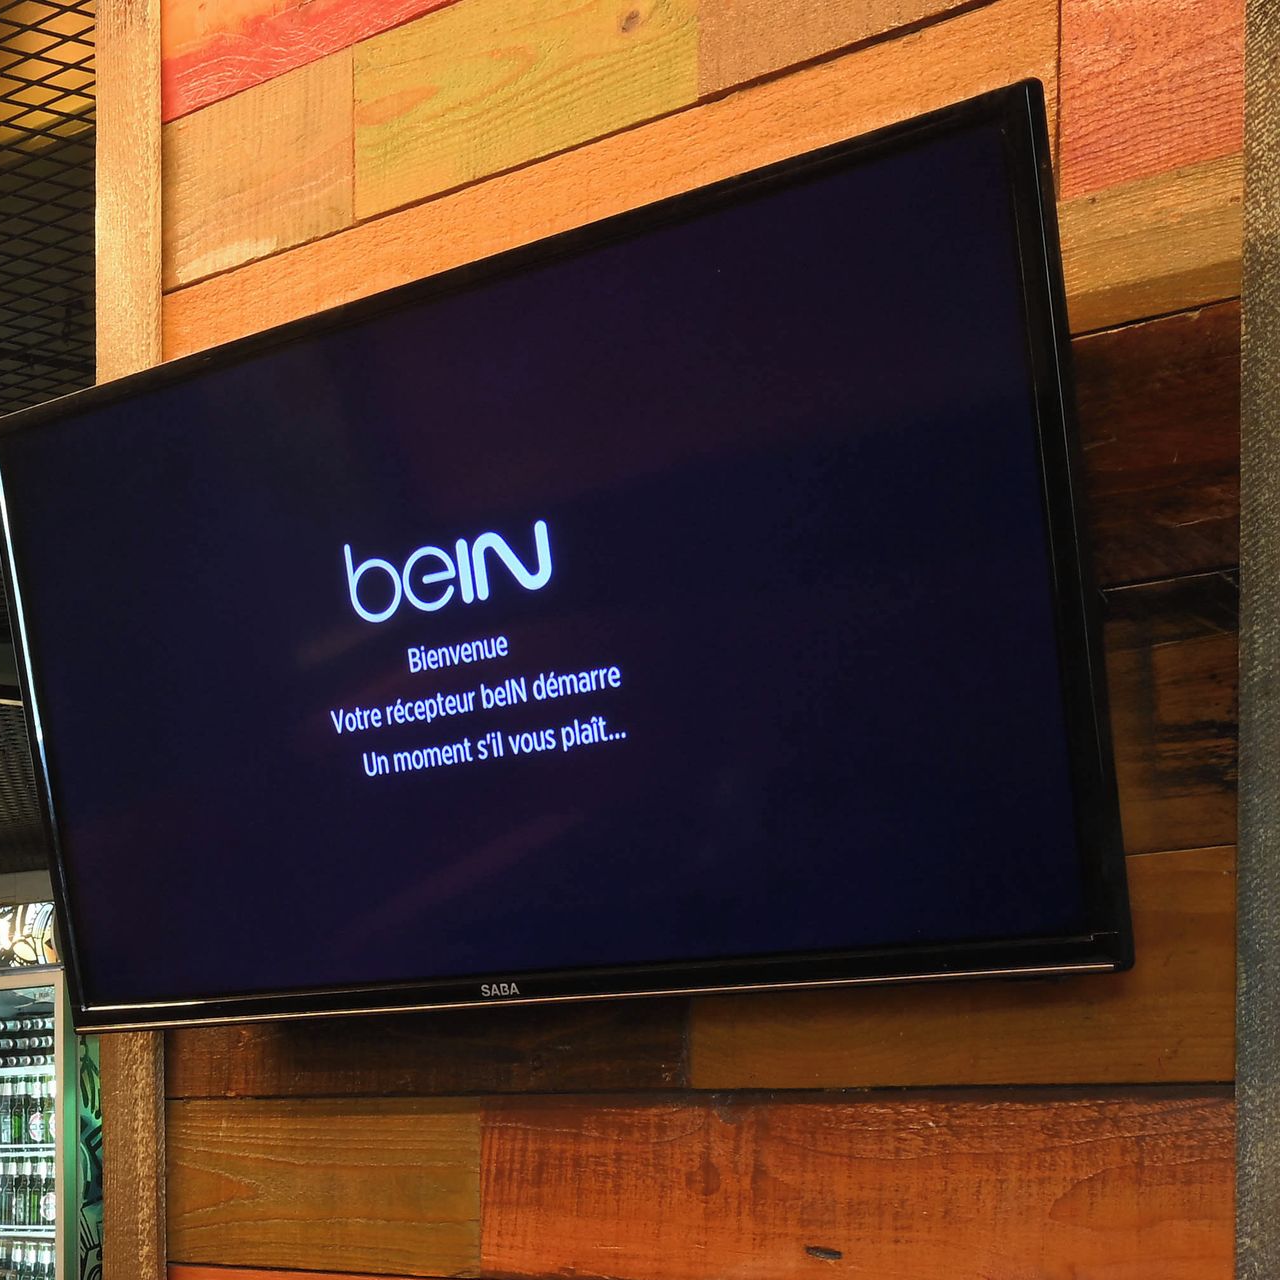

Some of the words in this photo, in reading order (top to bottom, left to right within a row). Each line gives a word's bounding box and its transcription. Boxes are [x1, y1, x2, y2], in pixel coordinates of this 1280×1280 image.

[344, 520, 552, 623] beIN
[407, 635, 509, 673] Bienvenue
[329, 707, 382, 735] Votre
[386, 690, 476, 723] récepteur
[480, 676, 528, 710] beIN
[532, 665, 621, 701] démarre
[363, 751, 389, 776] Un
[393, 737, 473, 773] moment
[478, 731, 504, 761] s'il
[509, 728, 556, 754] vous
[561, 716, 627, 752] plaît...
[480, 982, 520, 997] SABA
